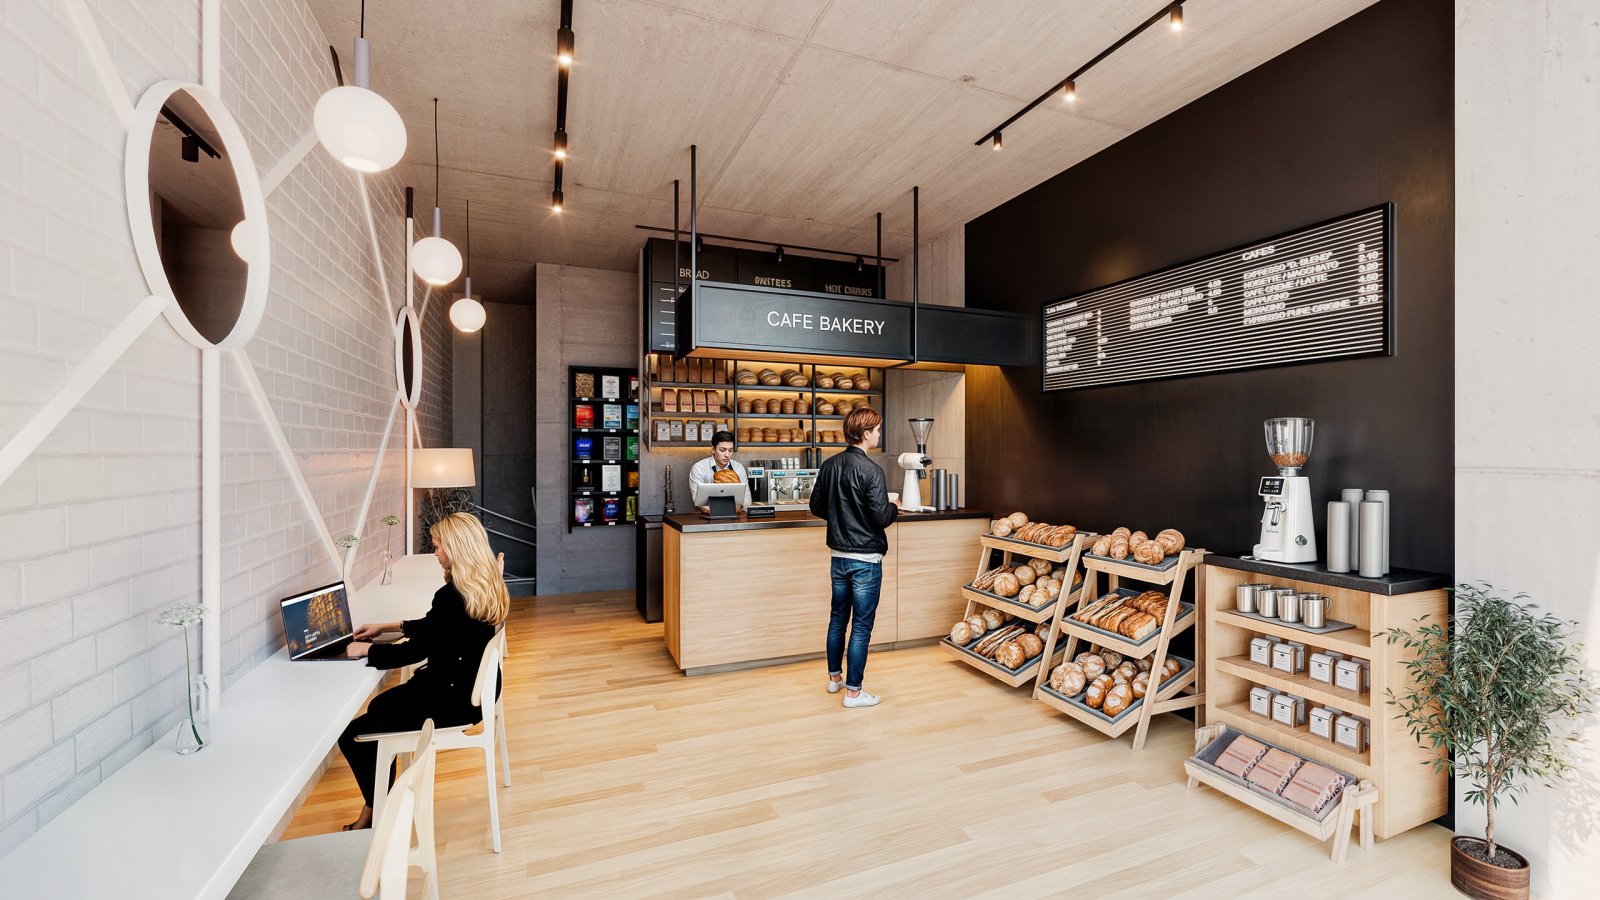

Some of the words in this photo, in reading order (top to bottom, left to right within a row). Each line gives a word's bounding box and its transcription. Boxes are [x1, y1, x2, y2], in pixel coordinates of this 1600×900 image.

[1242, 246, 1275, 260] CAFES
[1244, 264, 1286, 280] EXPRESSO
[1358, 244, 1366, 252] 2
[679, 268, 710, 280] BRAD
[1244, 274, 1282, 288] NOISETTE
[1358, 251, 1378, 262] 2.10
[1244, 288, 1264, 298] CAFE
[1266, 280, 1294, 292] CREME
[1299, 273, 1328, 286] LATTE
[1358, 262, 1378, 272] 3.20
[1358, 272, 1378, 283] 4.50
[844, 286, 873, 297] DRINKS
[1358, 283, 1378, 294] 4.50
[1358, 294, 1378, 304] 2.70
[767, 311, 813, 330] CAFE
[819, 315, 885, 335] BAKERY
